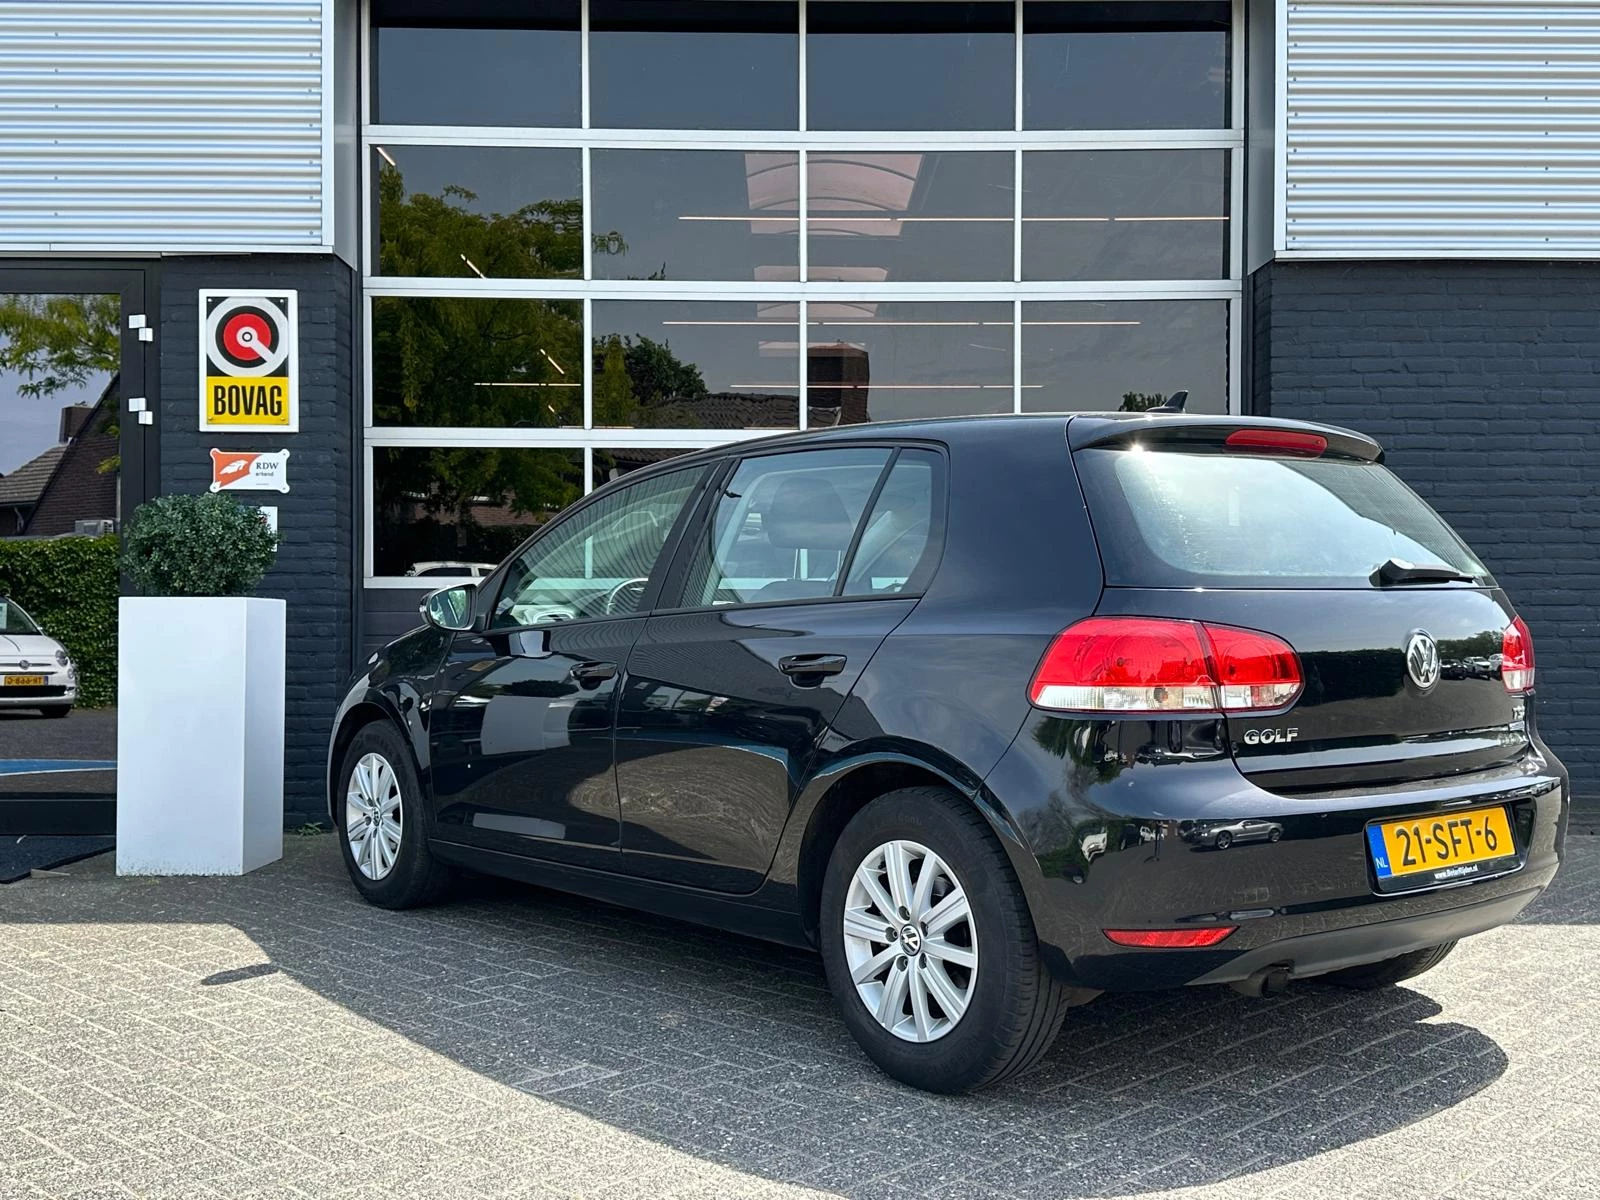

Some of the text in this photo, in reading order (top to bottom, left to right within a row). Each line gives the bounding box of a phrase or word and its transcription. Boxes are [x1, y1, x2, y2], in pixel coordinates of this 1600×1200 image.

[213, 384, 282, 416] BOVAG
[256, 462, 279, 470] RDW
[1244, 727, 1299, 745] GOLF
[1395, 816, 1498, 867] 21-SFT-6
[1375, 857, 1389, 869] NL
